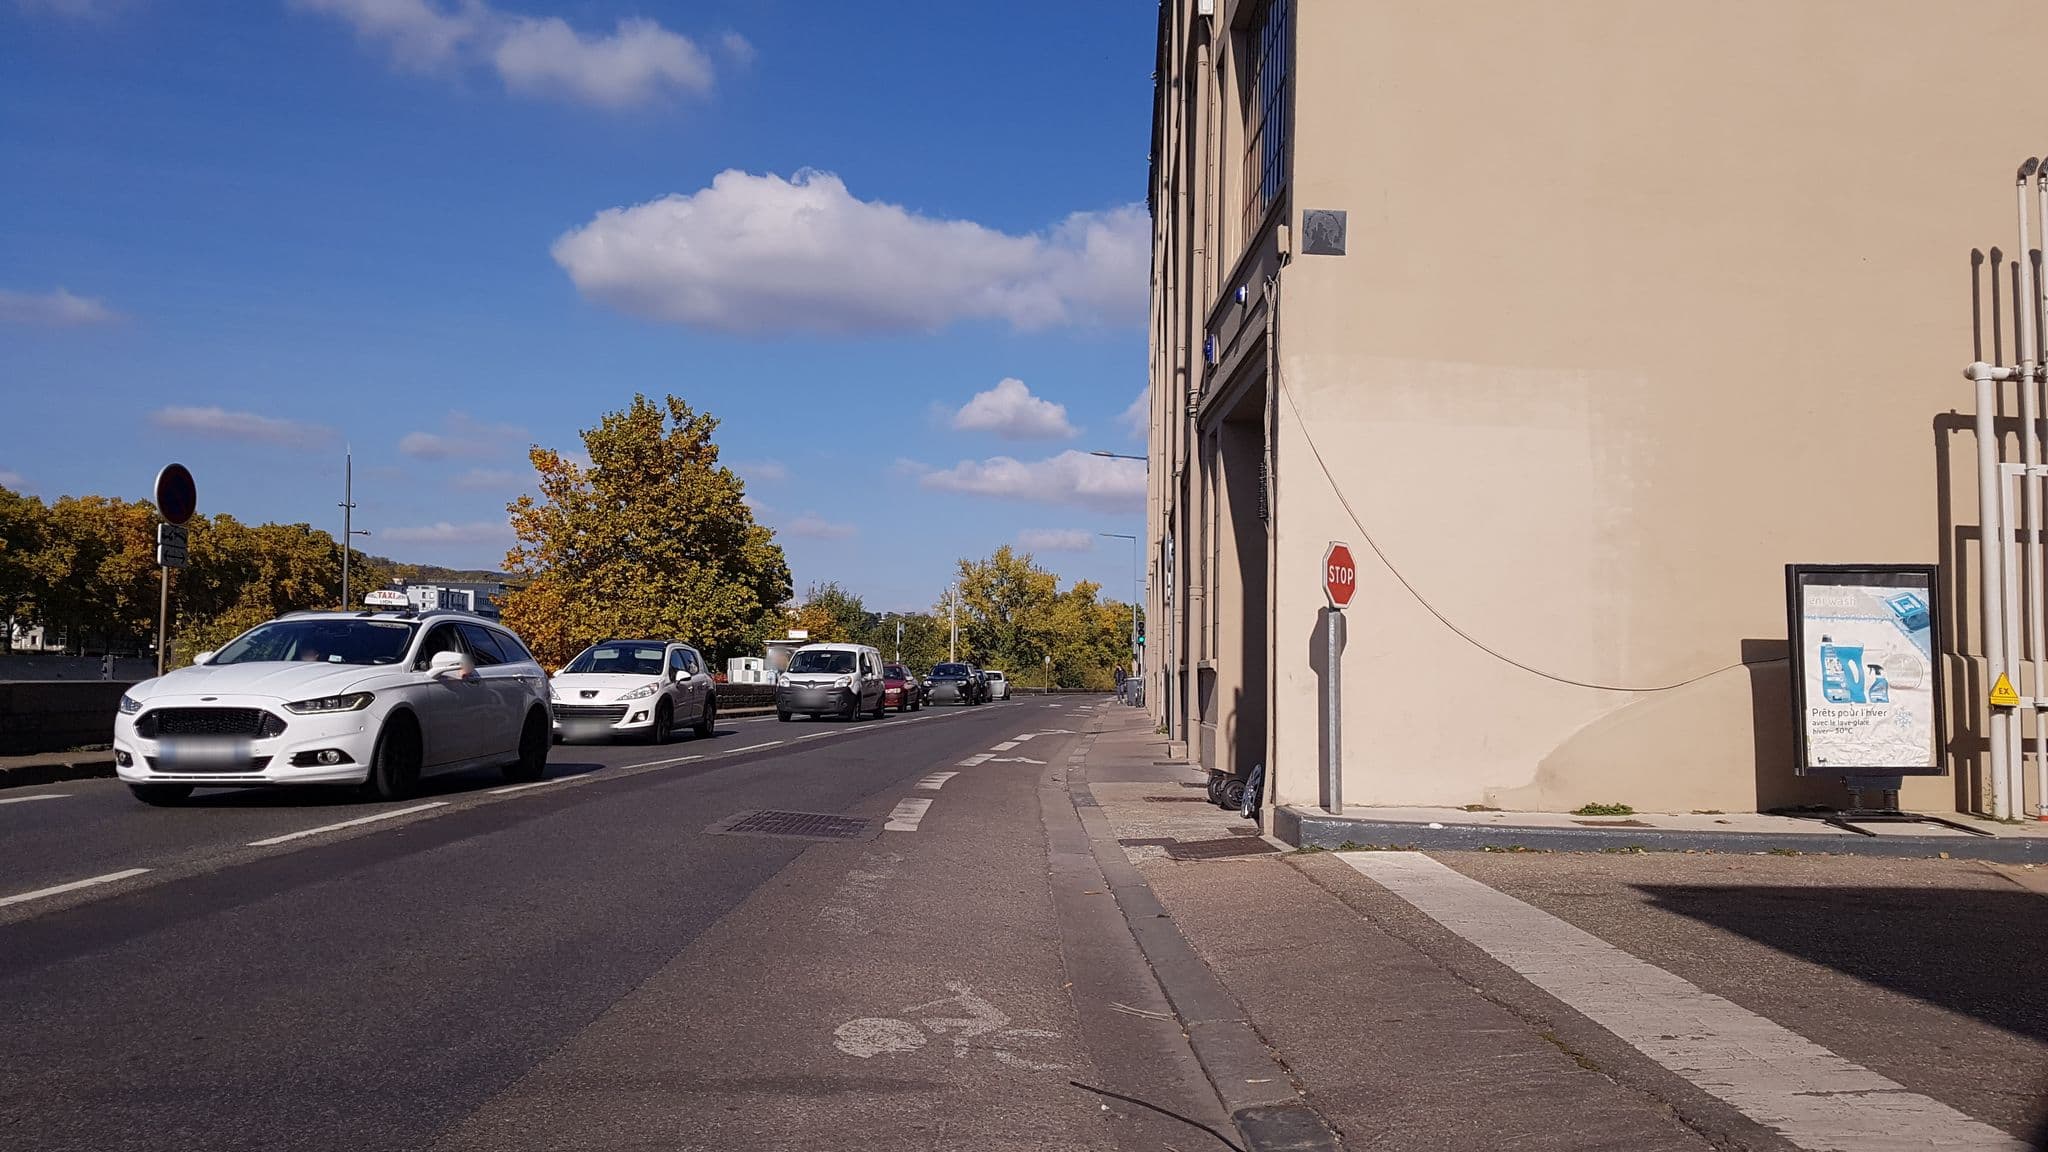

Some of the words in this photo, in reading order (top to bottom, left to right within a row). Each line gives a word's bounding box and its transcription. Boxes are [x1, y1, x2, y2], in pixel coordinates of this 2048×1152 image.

[1328, 565, 1354, 585] STOP
[377, 591, 397, 600] TAXI
[1998, 687, 2010, 695] EX
[1812, 707, 1836, 718] Prêts
[1838, 710, 1860, 719] pour
